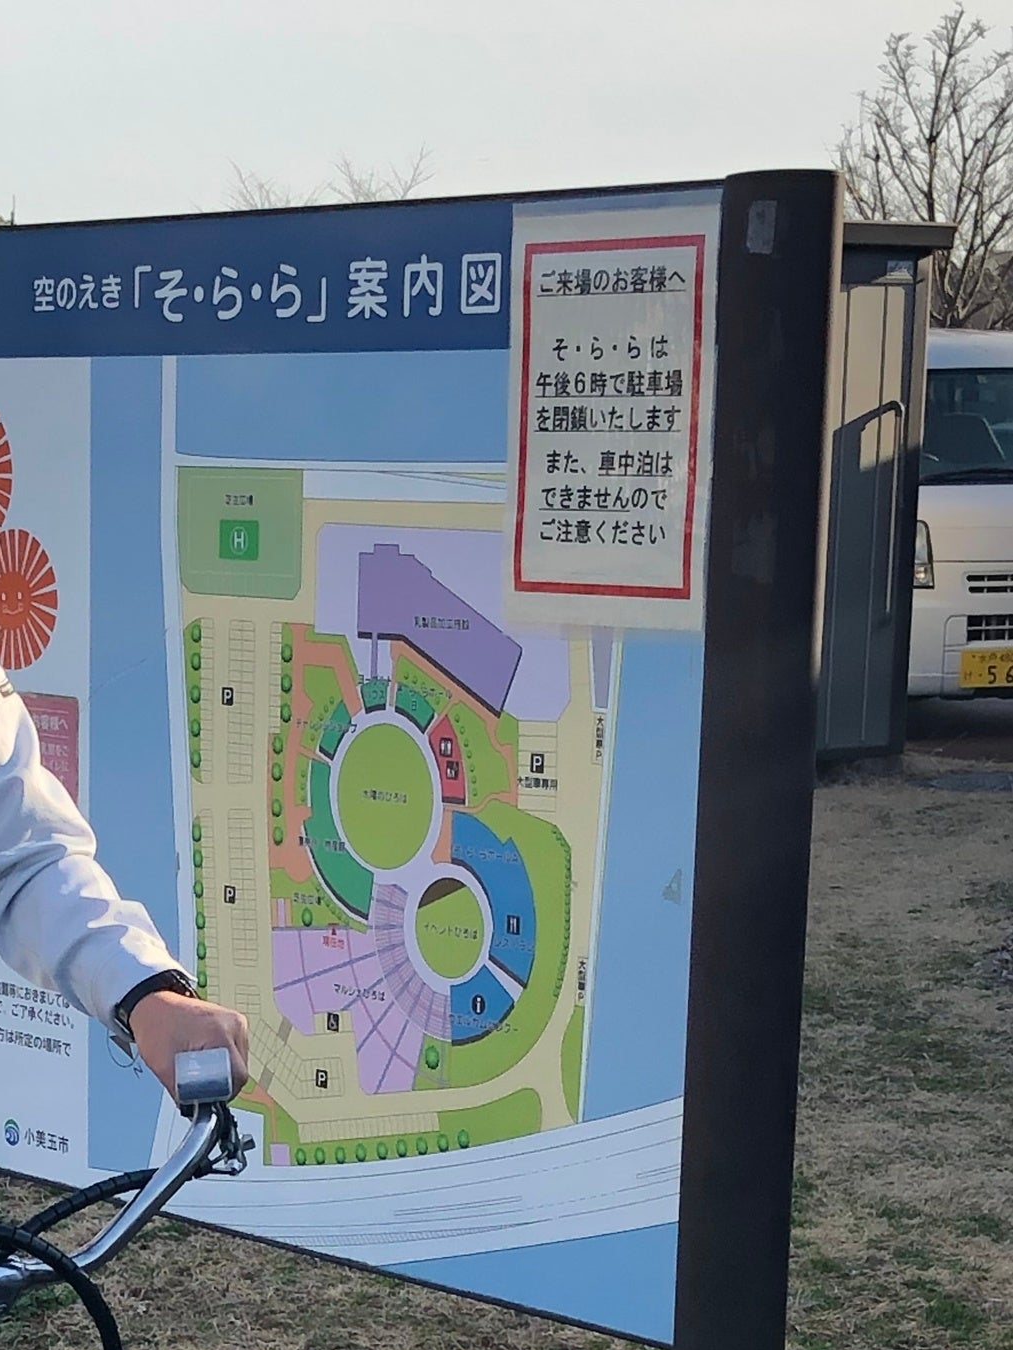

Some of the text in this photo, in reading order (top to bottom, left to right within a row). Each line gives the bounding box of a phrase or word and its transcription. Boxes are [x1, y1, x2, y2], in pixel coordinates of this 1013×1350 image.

[540, 265, 685, 294] ご来場のお客様へ
[536, 369, 683, 396] 午後6時で駐車場
[536, 405, 681, 431] を閉鎖いたします
[541, 485, 667, 510] できませんので
[540, 518, 666, 545] ご注意ください
[24, 1127, 69, 1154] 小美玉市
